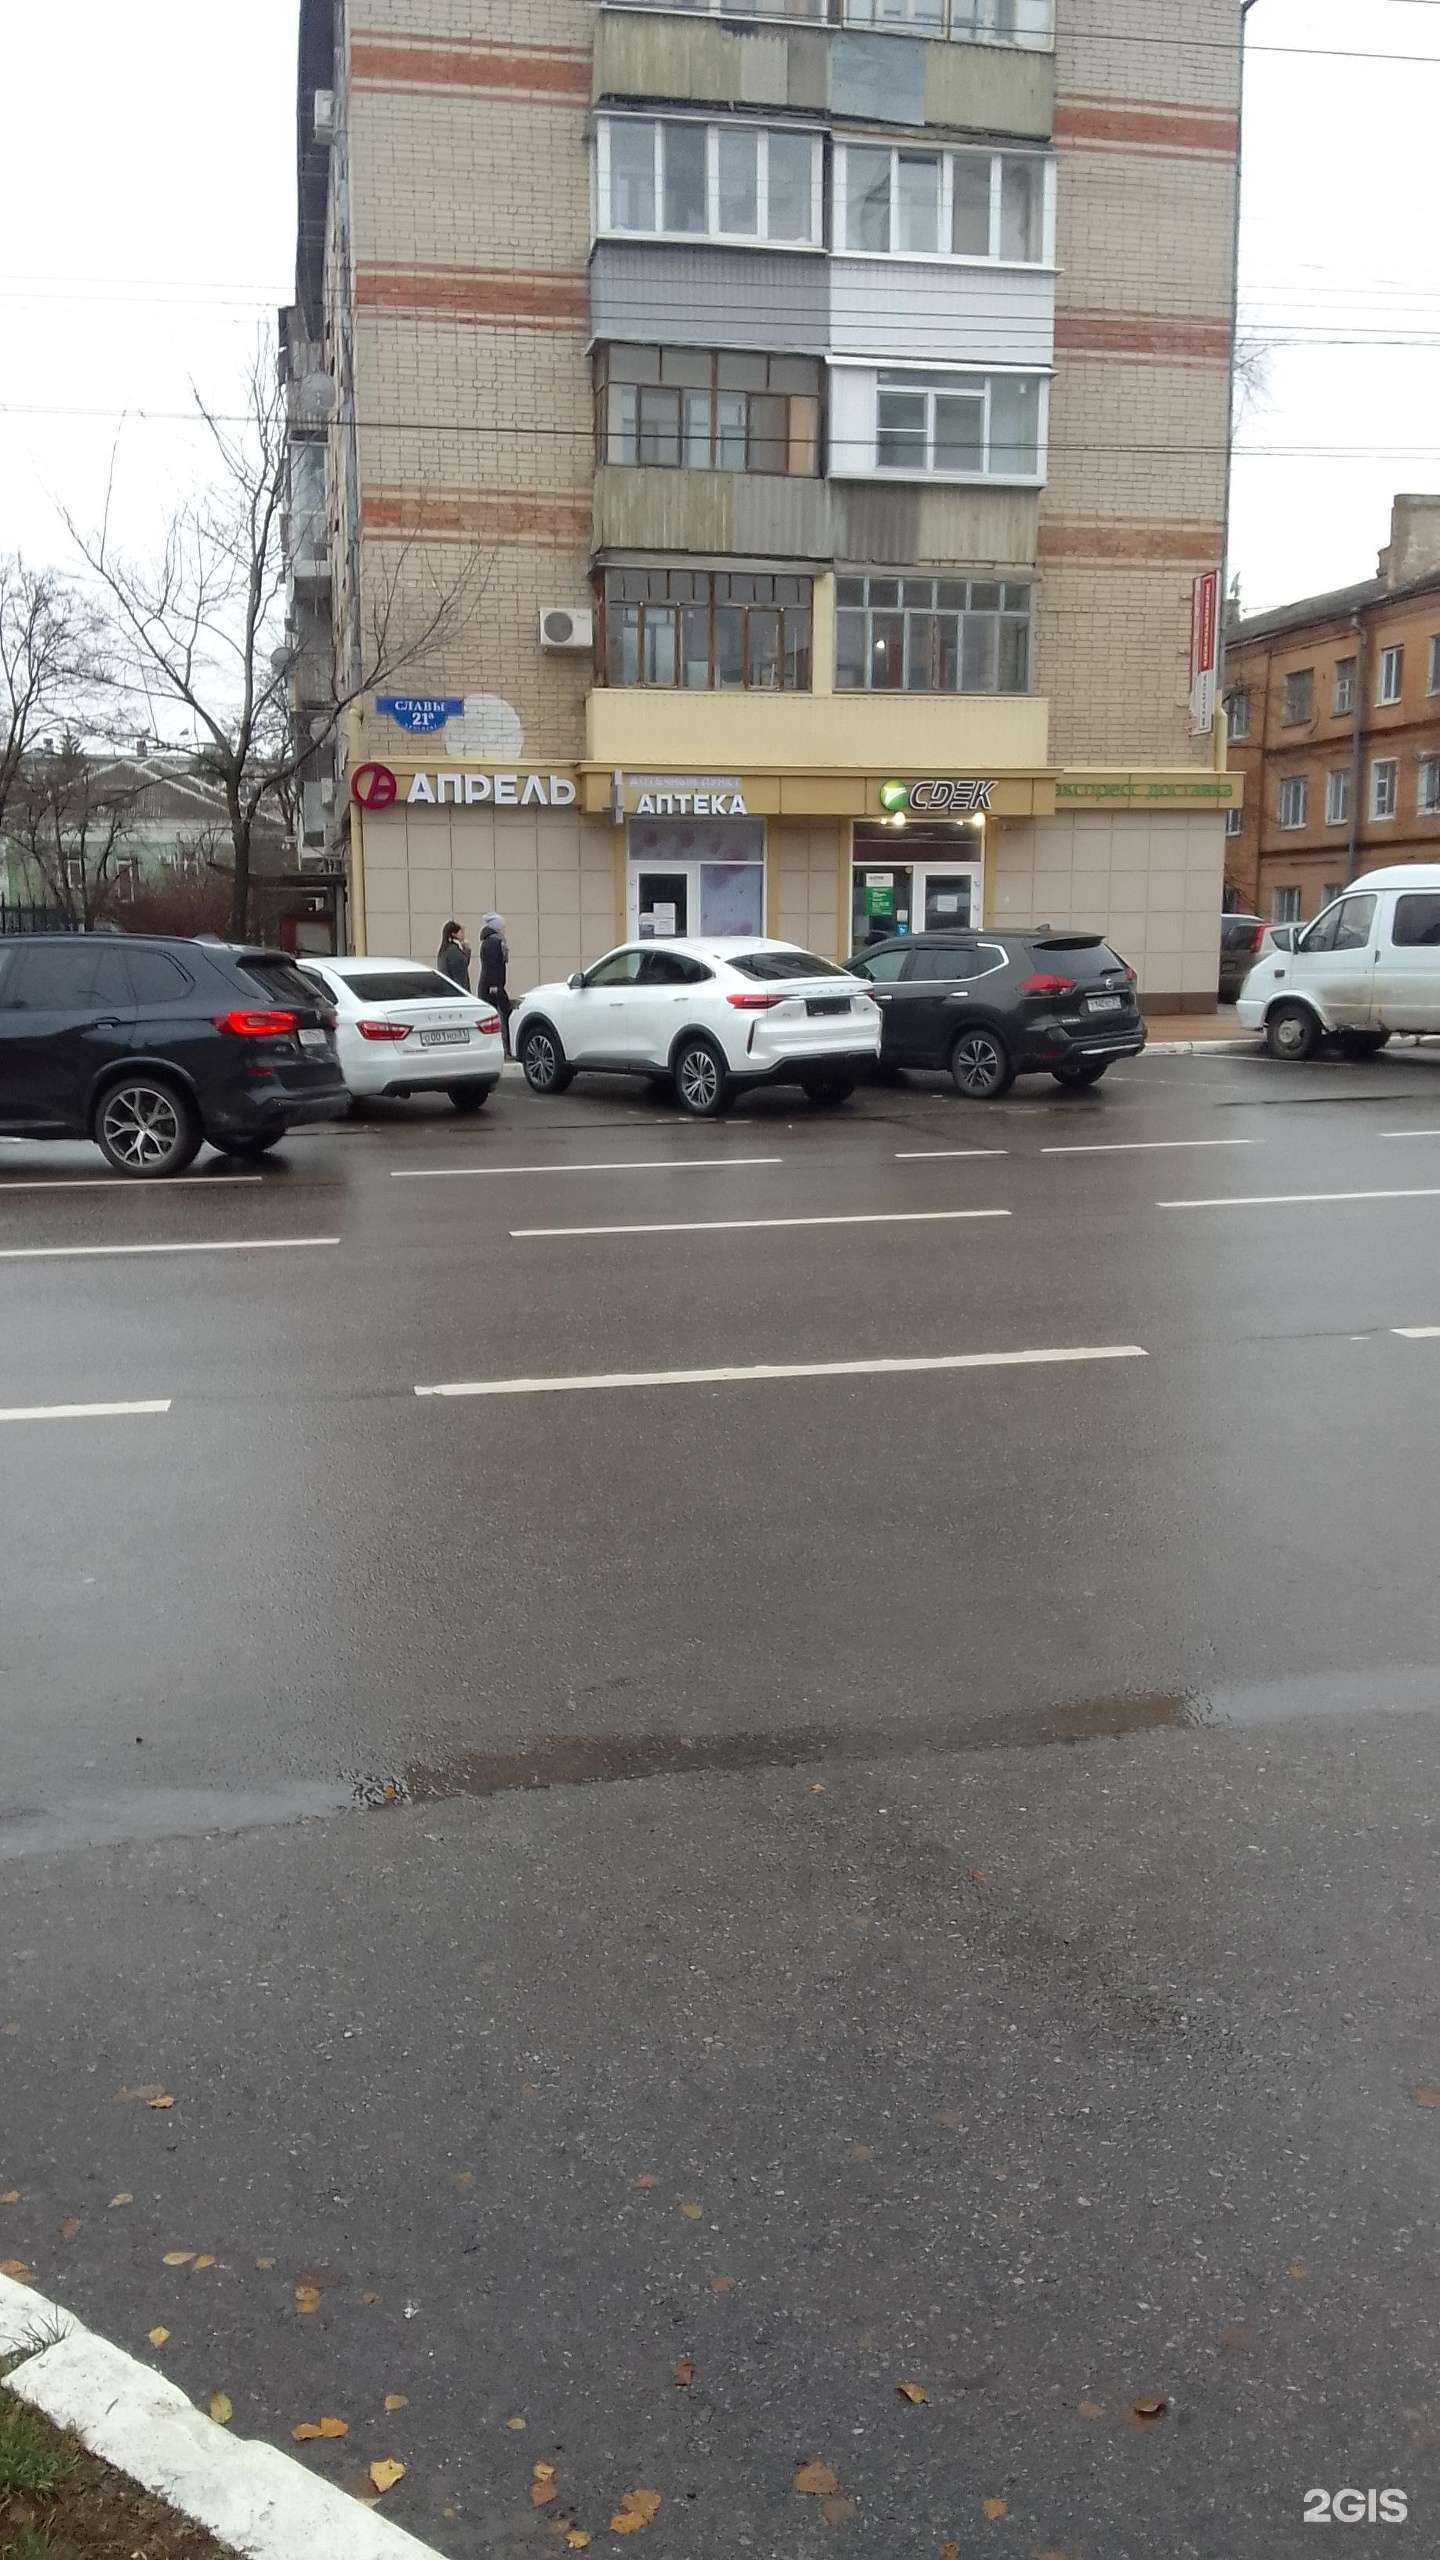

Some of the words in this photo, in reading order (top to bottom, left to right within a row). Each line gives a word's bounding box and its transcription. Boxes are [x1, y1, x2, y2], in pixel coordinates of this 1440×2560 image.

[395, 700, 445, 711] СЛАВЫ
[407, 773, 576, 805] АПРЕЛЬ
[910, 781, 999, 809] CDEK
[636, 794, 748, 815] АПТЕКА
